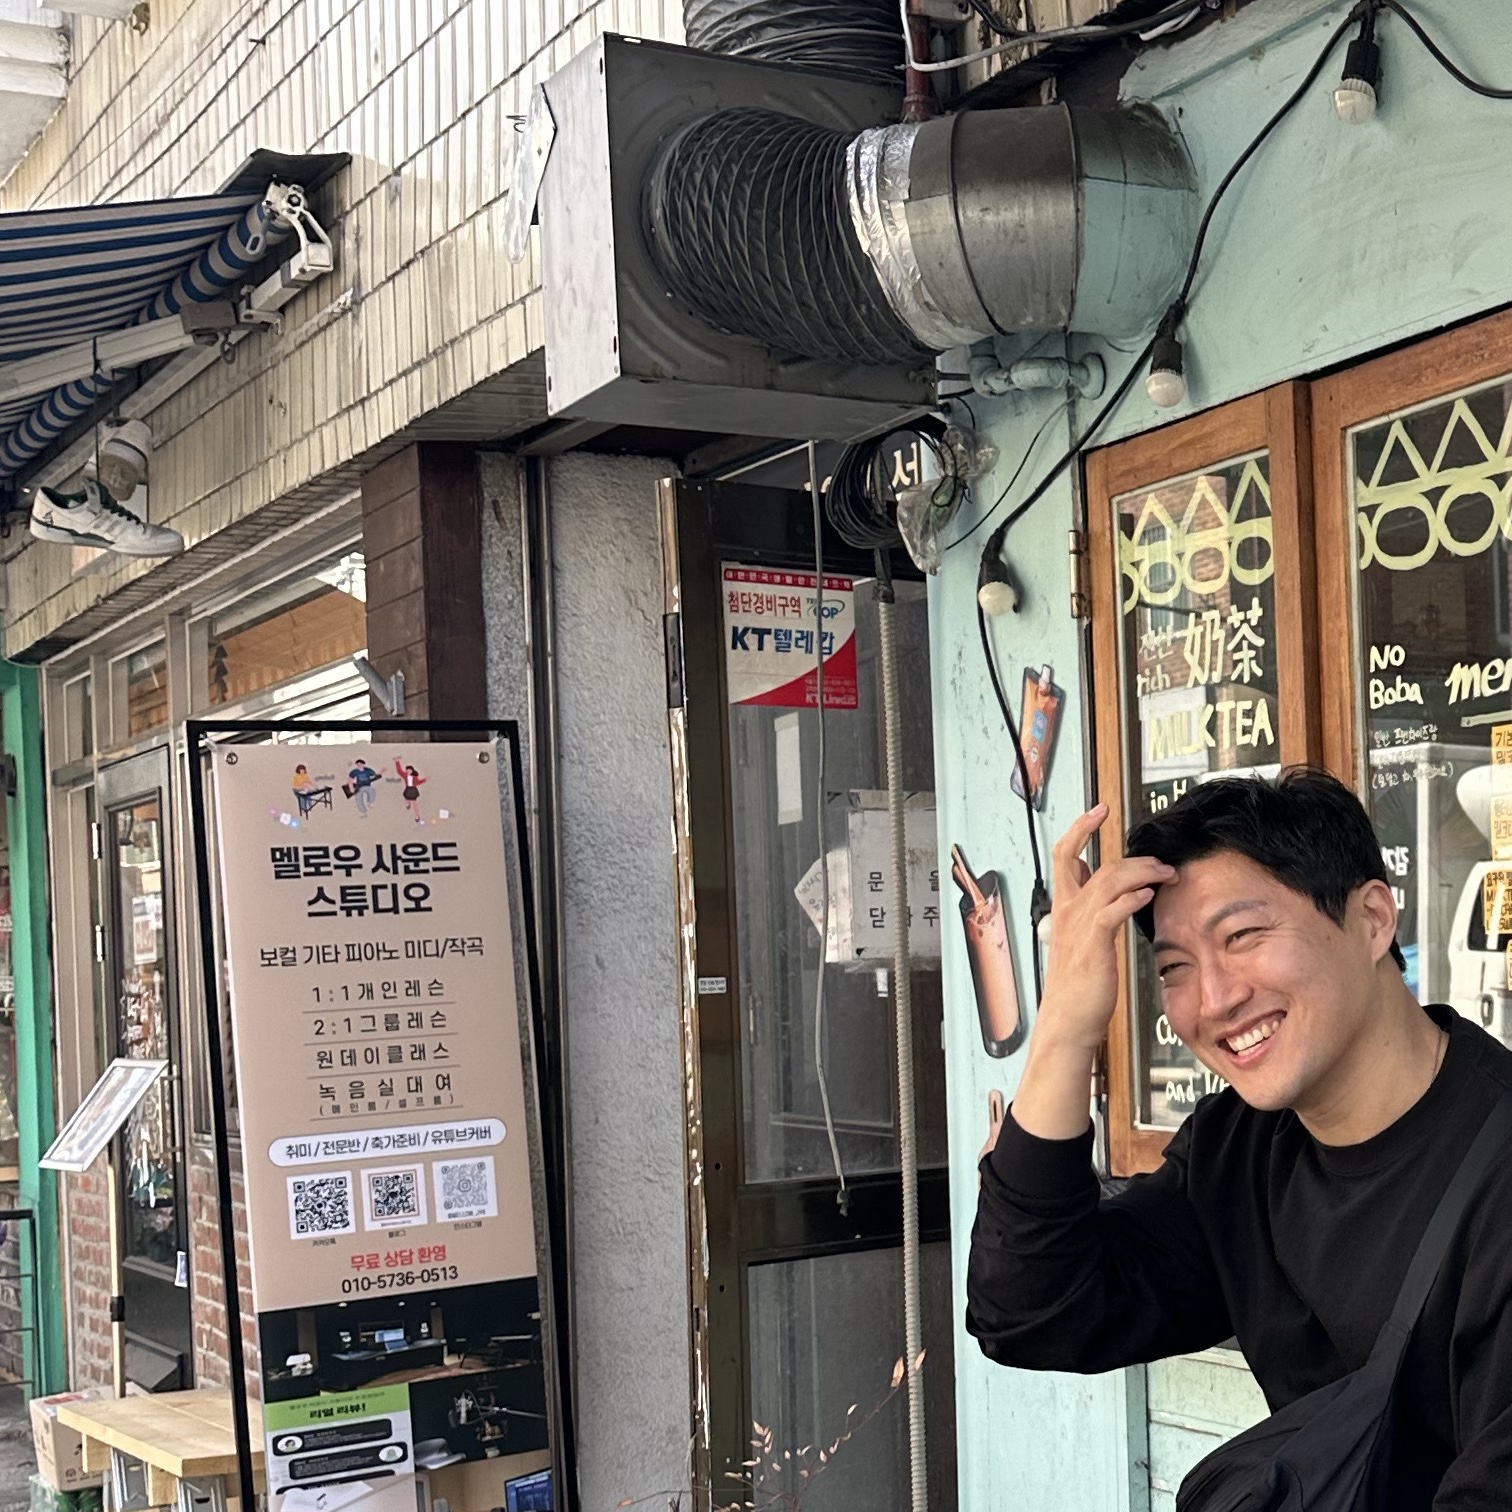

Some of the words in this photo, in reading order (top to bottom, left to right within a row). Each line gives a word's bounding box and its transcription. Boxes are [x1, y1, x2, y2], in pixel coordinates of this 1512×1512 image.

[728, 591, 802, 618] 첨단경비구역
[1178, 597, 1266, 688] 奶茶
[1369, 645, 1406, 673] NO
[1137, 664, 1171, 697] rich
[1369, 675, 1424, 710] Boba
[1150, 791, 1168, 814] in
[269, 843, 364, 880] 멜로우
[371, 841, 461, 876] 사운드
[306, 881, 433, 918] 스튜디오
[260, 947, 298, 968] 보컬
[302, 944, 341, 965] 기타
[345, 940, 401, 963] 피아노
[404, 936, 485, 960] 미디/작곡
[1165, 1073, 1196, 1103] and
[350, 1253, 381, 1272] 무료
[384, 1248, 415, 1268] 상담
[417, 1244, 448, 1263] 환영
[341, 1265, 459, 1294] 010-5736-0513
